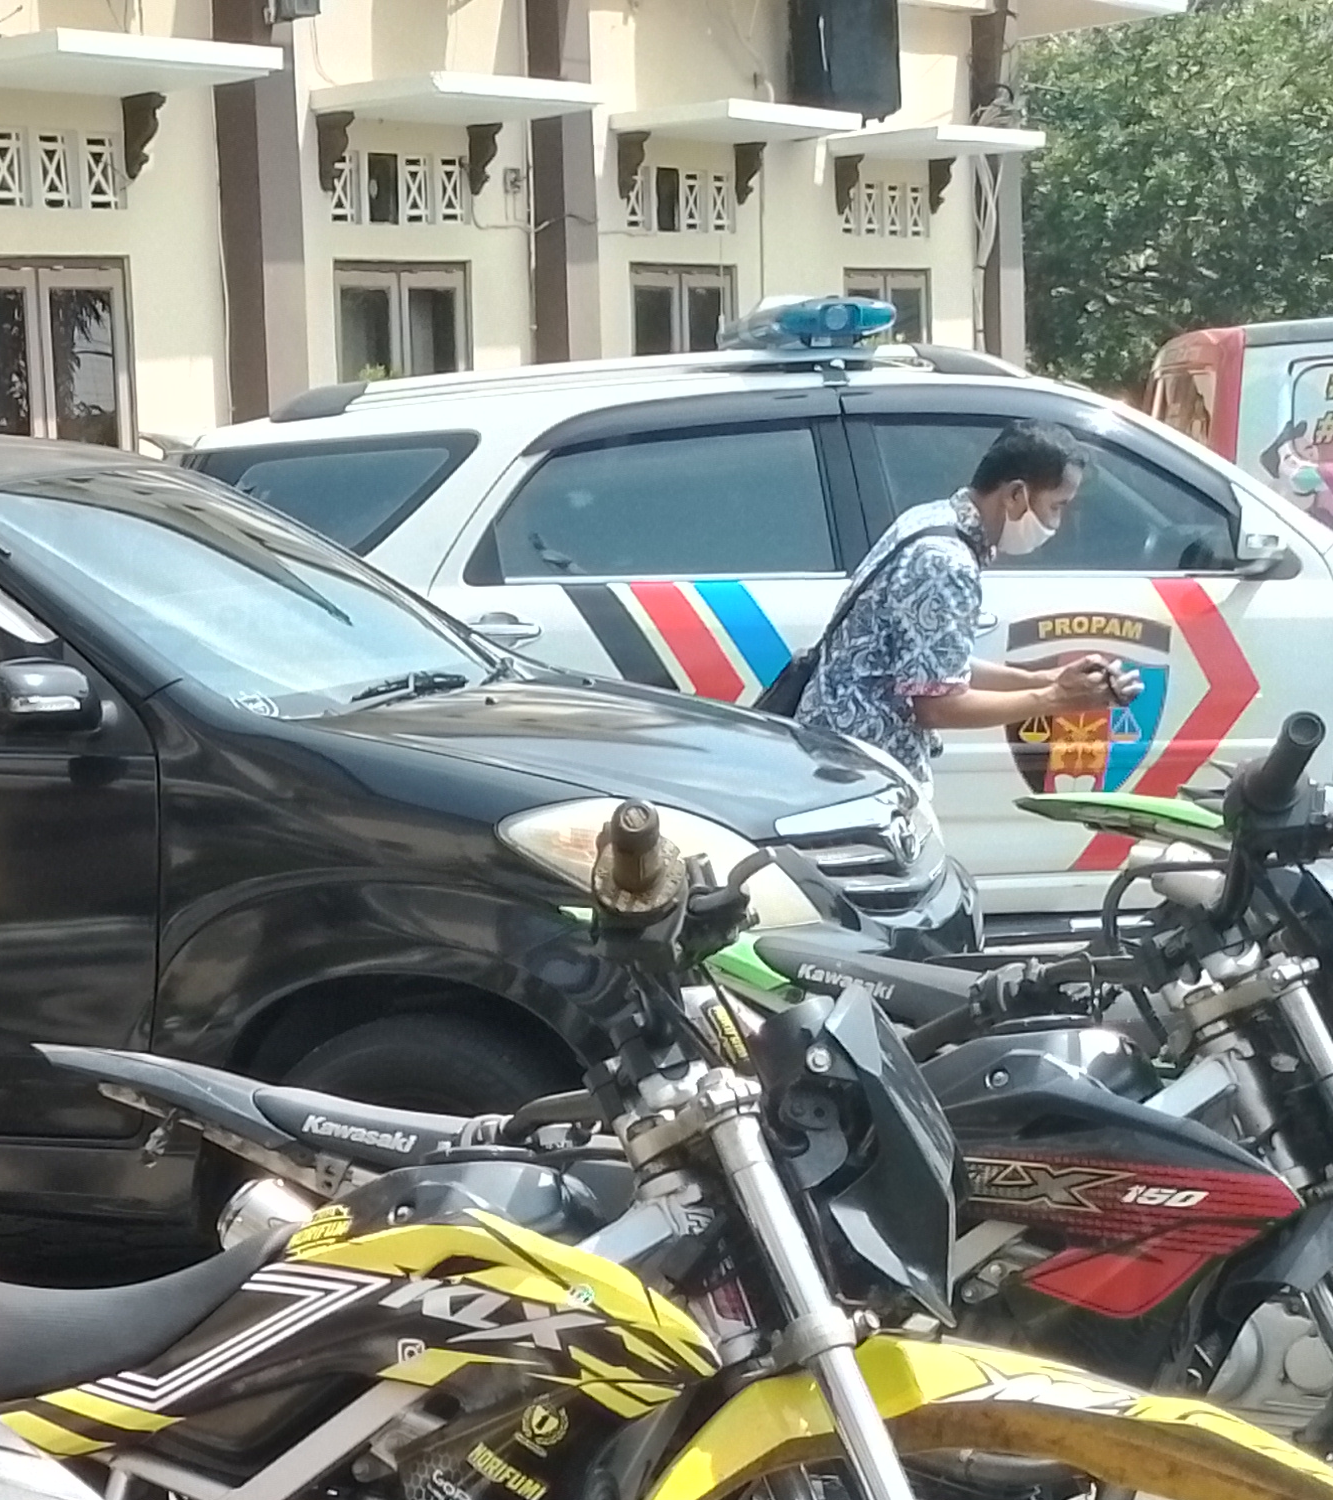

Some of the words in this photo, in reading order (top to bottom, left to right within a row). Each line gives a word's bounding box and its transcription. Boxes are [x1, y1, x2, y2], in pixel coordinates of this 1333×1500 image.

[1038, 616, 1143, 639] PROPAM
[301, 1114, 418, 1153] Kawasaki
[1121, 1184, 1210, 1208] 150
[378, 1278, 607, 1351] KLX
